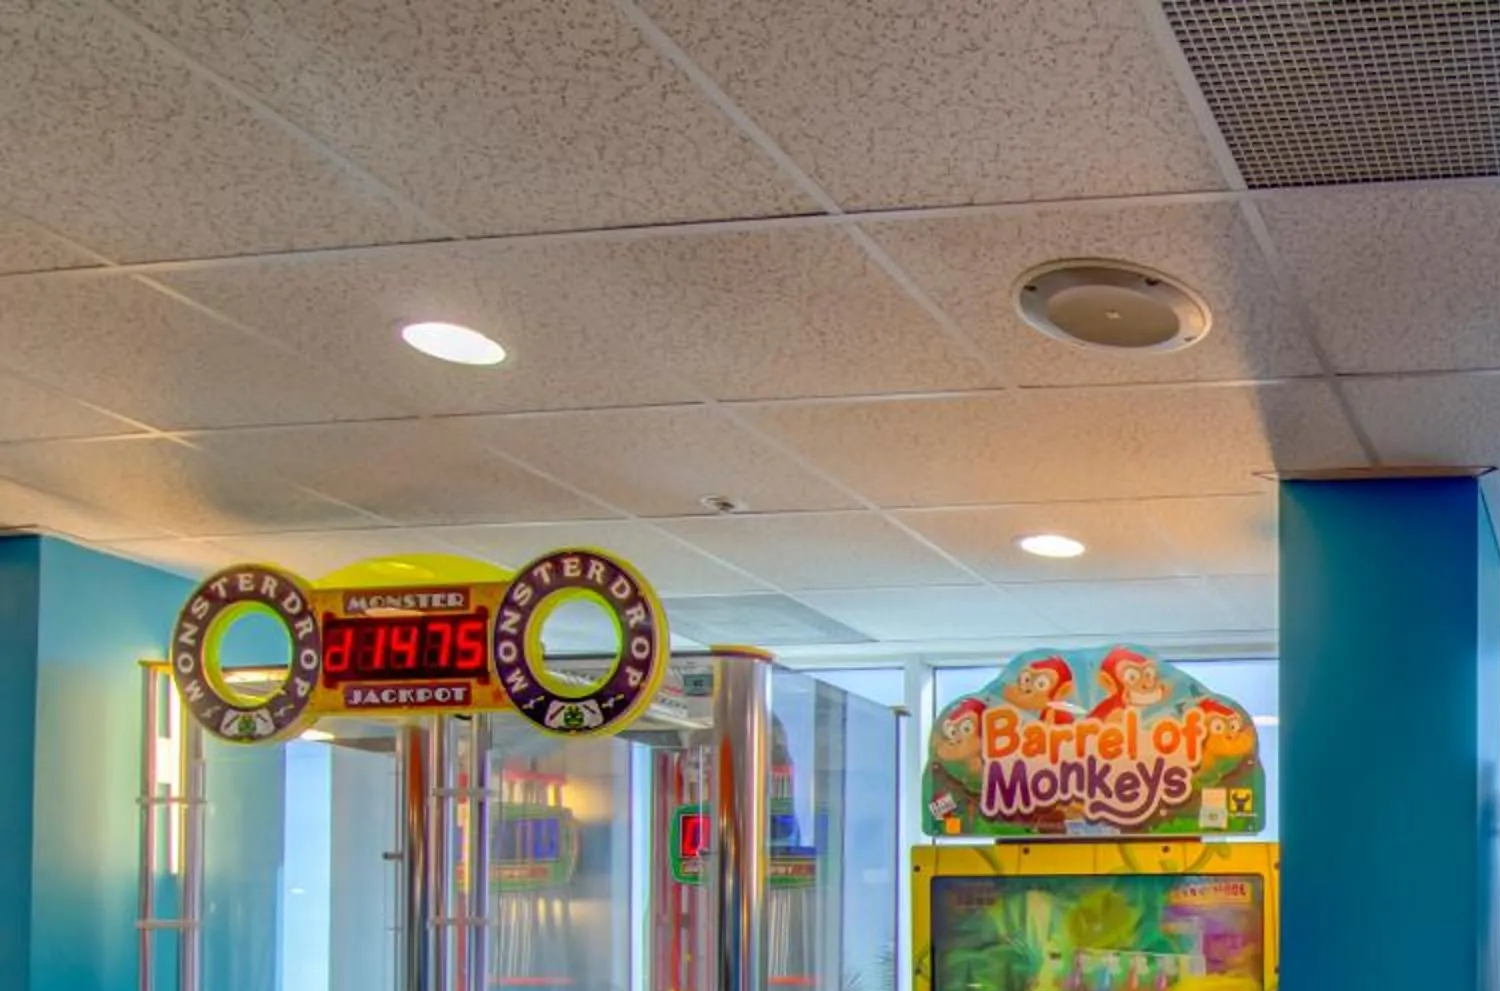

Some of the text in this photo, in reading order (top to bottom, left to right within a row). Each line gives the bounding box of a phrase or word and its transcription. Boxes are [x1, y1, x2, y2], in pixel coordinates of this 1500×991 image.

[347, 592, 465, 611] MONSTER
[349, 686, 469, 706] JACKPOT
[984, 707, 1205, 764] Barrel of
[983, 753, 1190, 822] Monkeys
